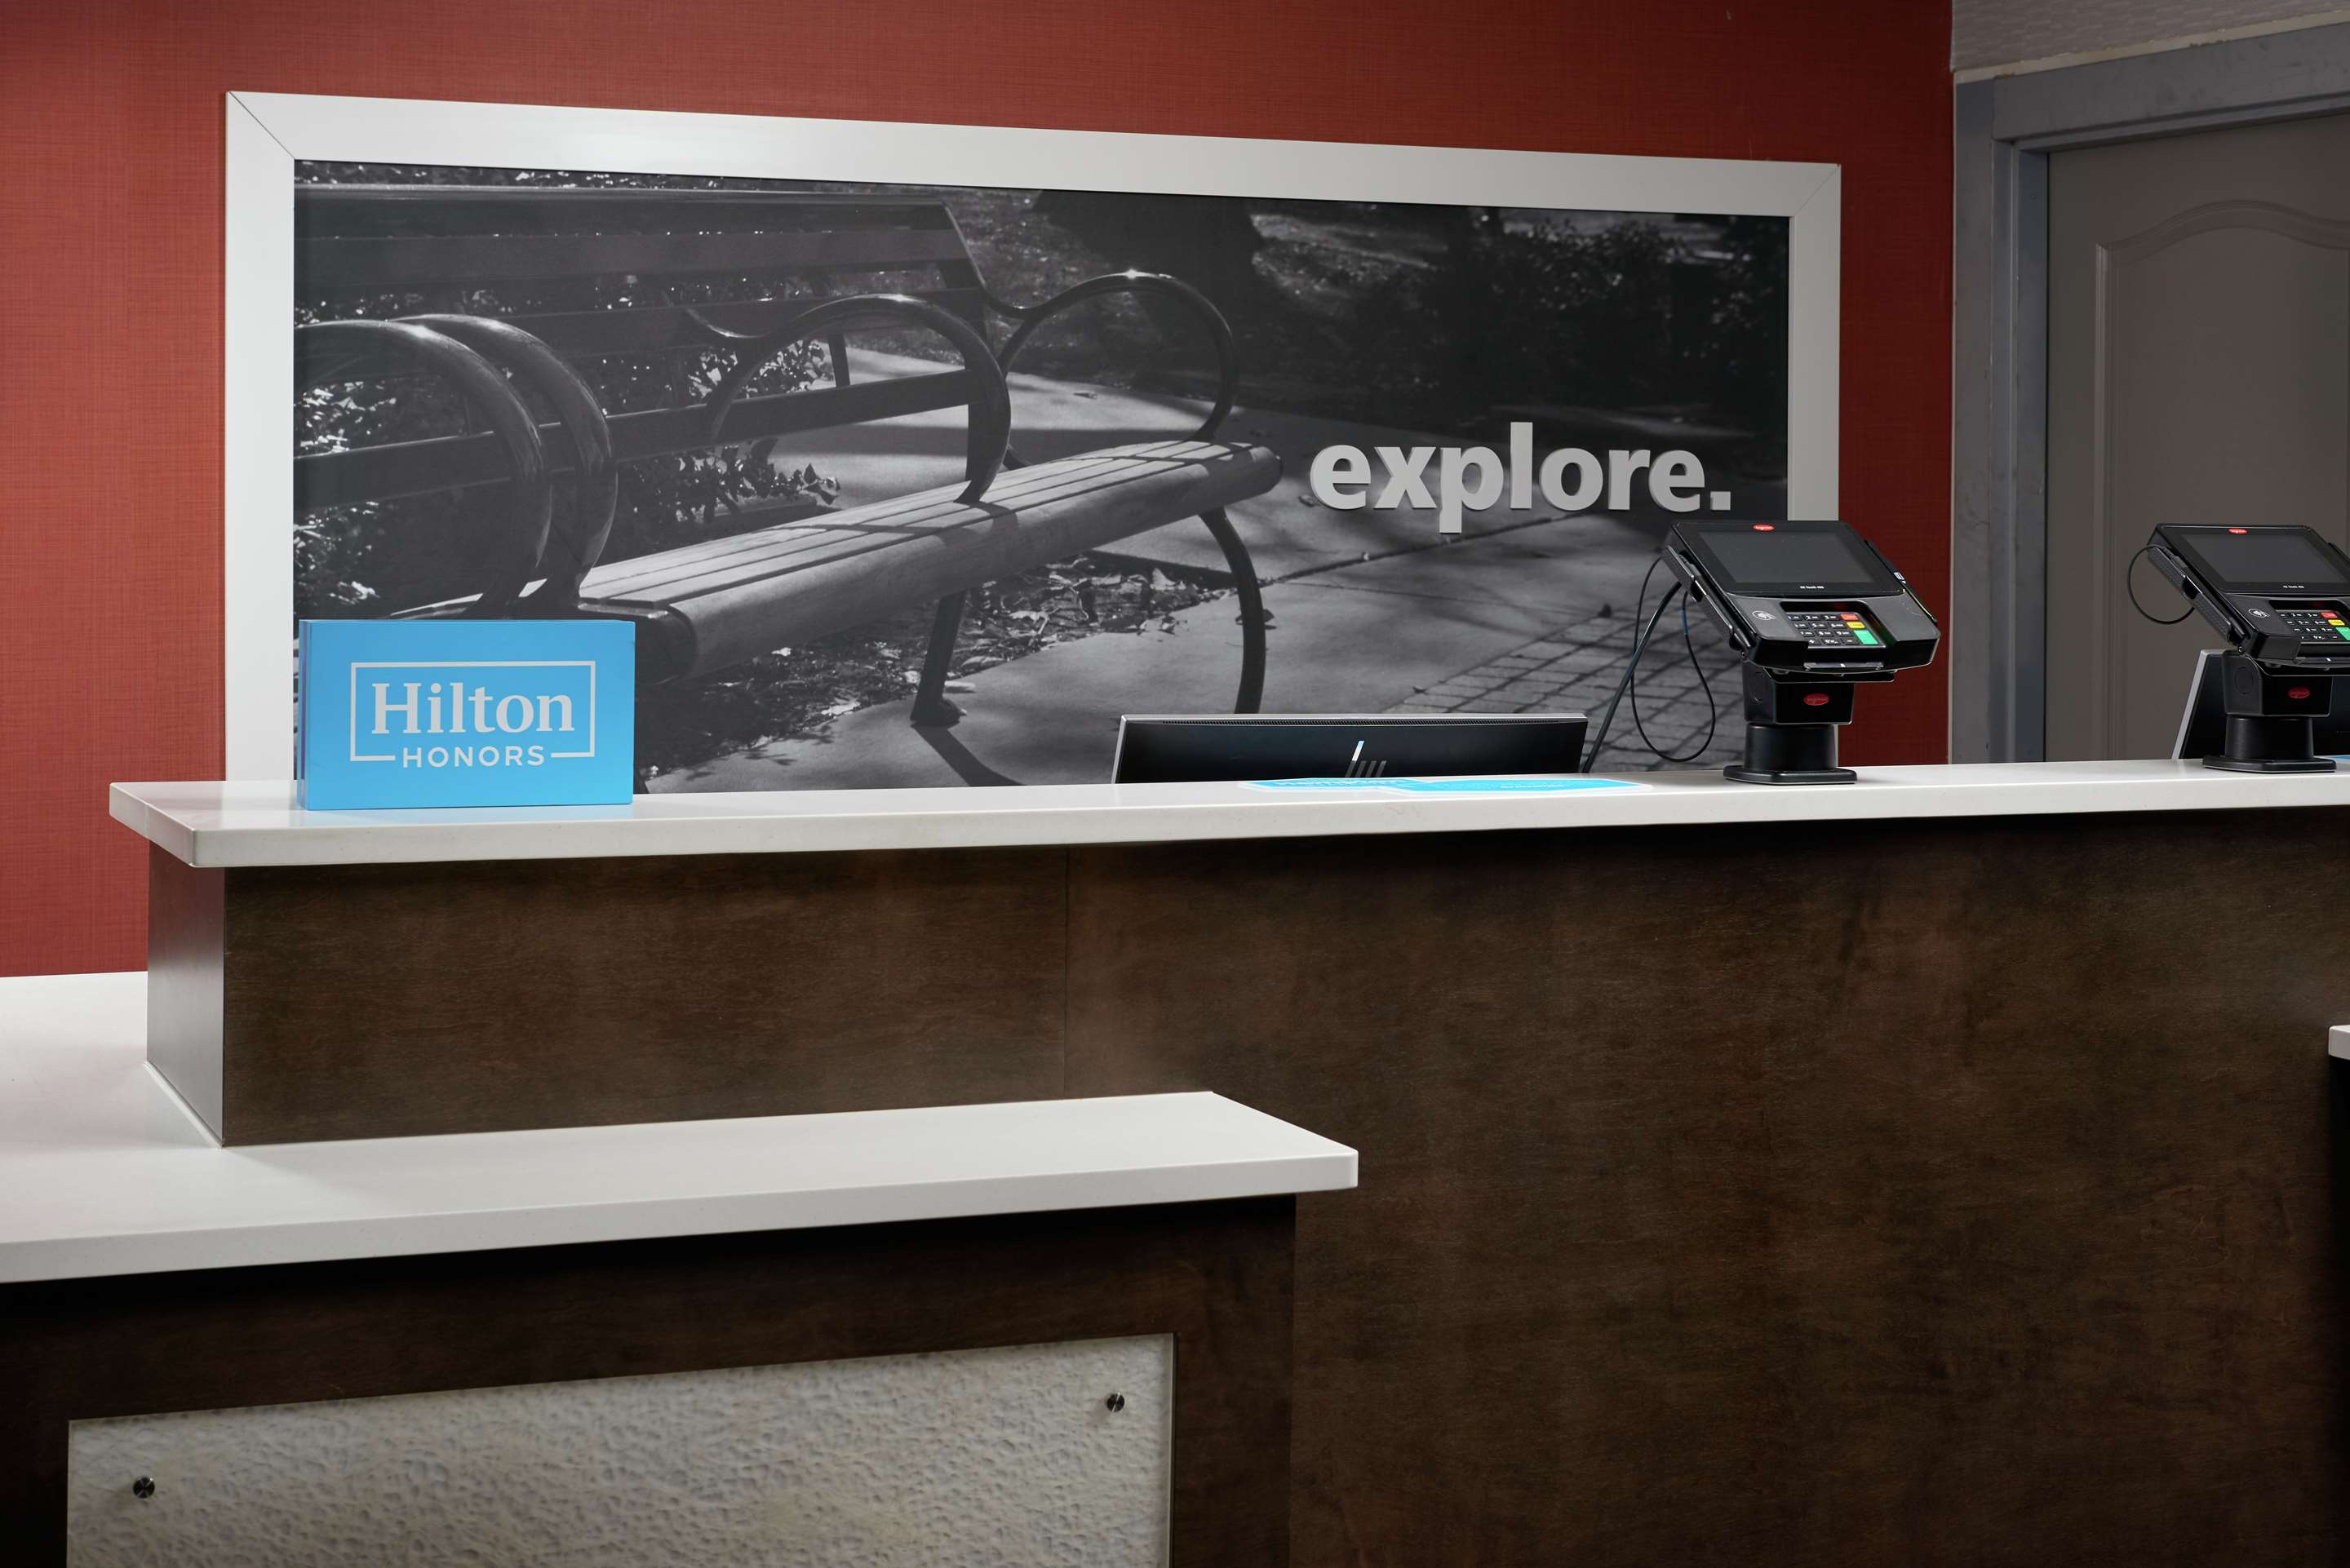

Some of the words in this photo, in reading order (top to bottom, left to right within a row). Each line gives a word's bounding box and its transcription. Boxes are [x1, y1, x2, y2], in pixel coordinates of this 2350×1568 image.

[1310, 422, 1731, 534] explore.
[371, 682, 575, 734] Hilton
[402, 745, 546, 768] HONORS
